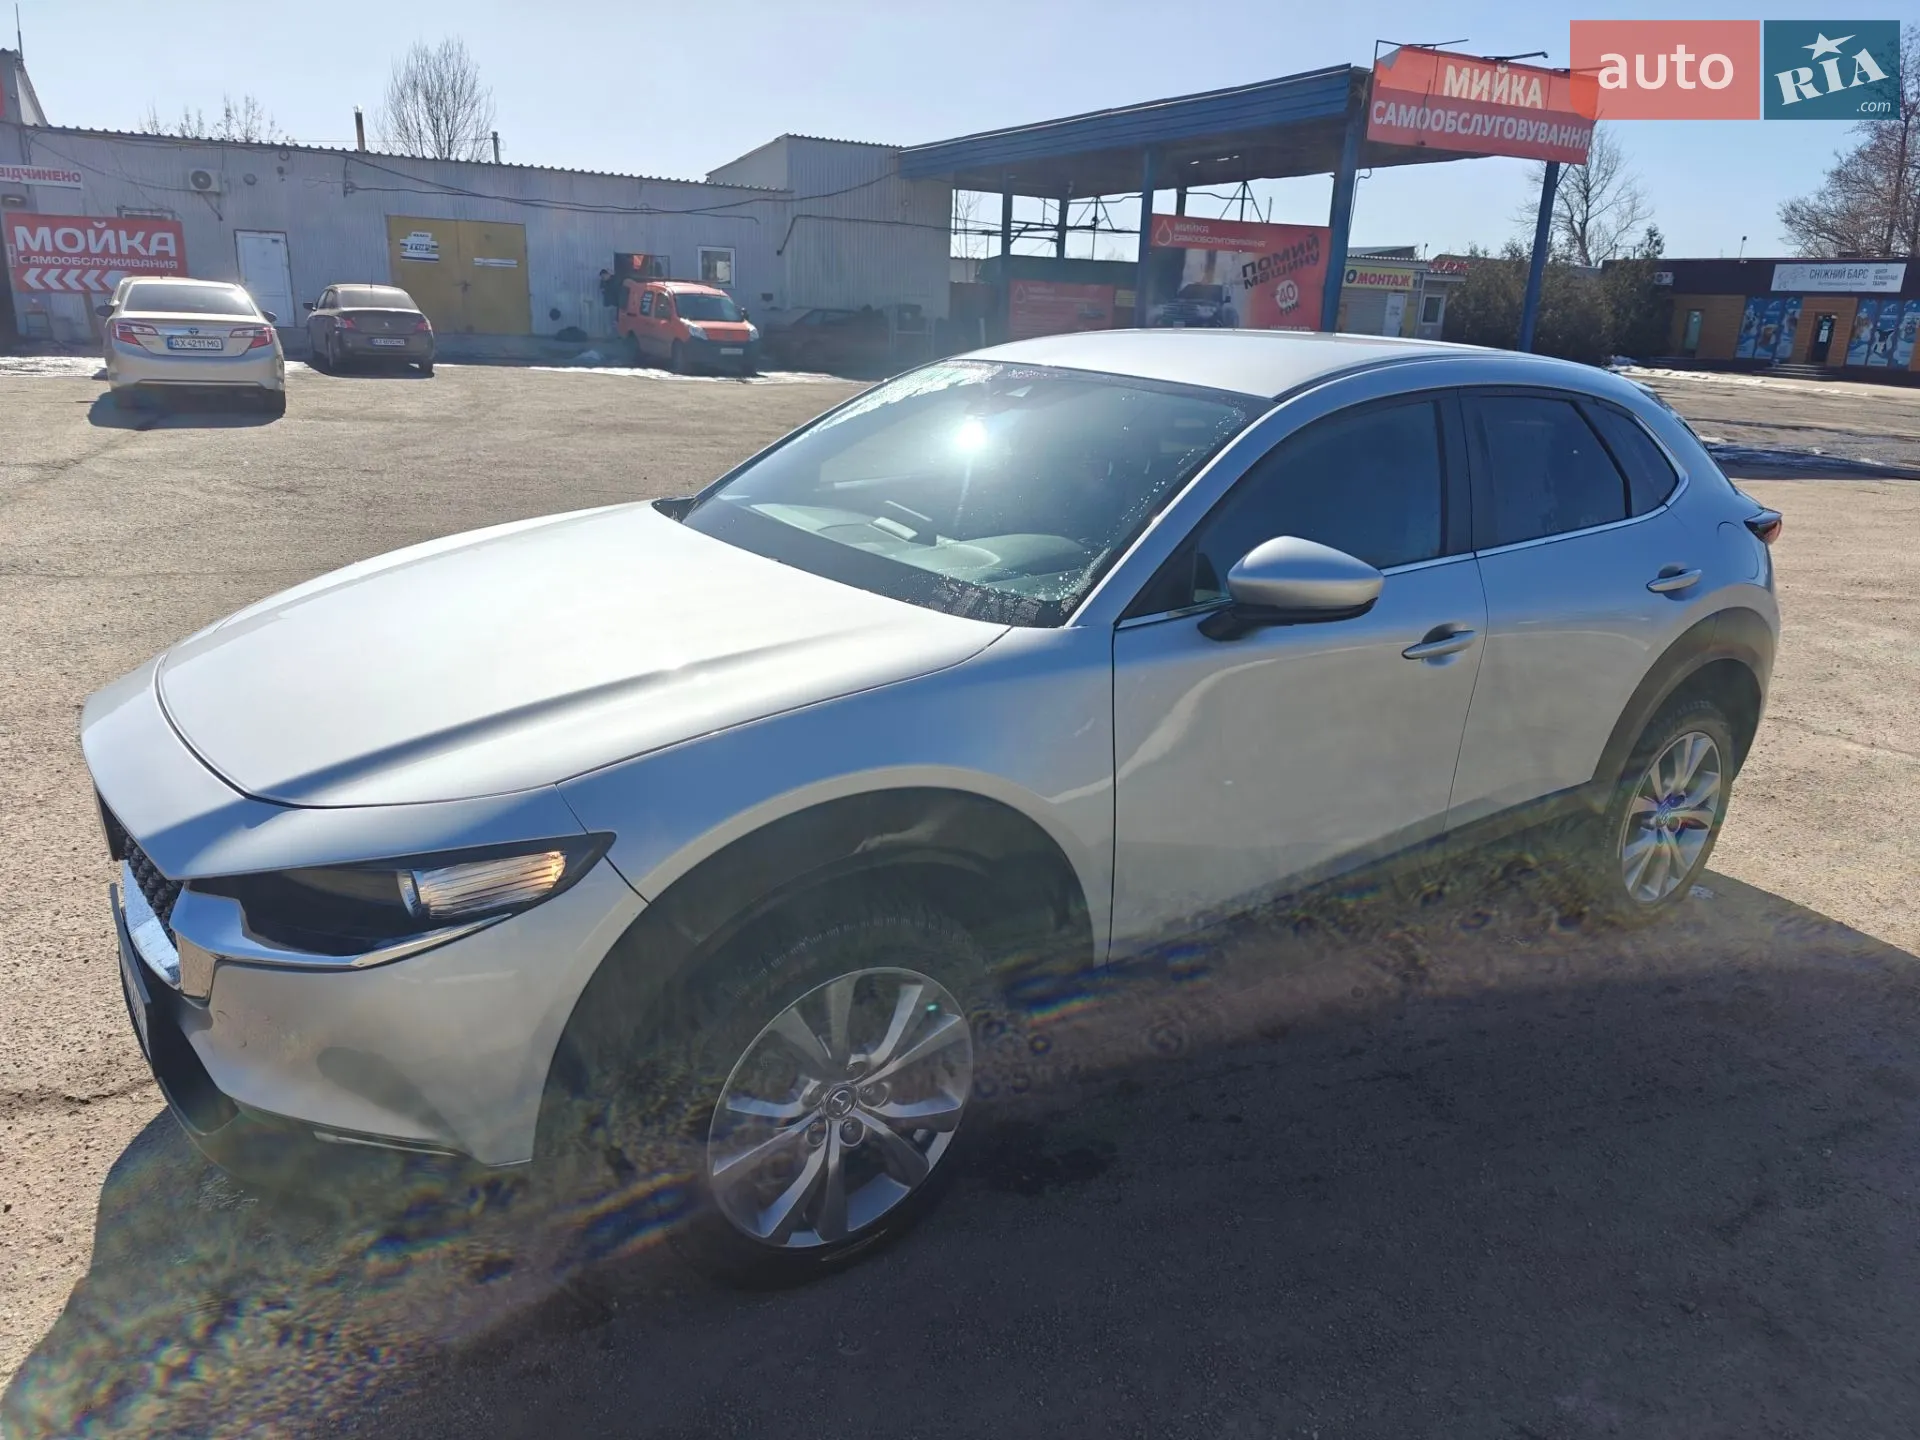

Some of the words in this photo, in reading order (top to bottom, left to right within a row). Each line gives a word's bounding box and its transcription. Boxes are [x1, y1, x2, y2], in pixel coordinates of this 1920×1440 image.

[1442, 63, 1544, 110] МИЙКА
[1371, 101, 1592, 150] САМООБСЛУГОВУВАННЯ
[0, 166, 82, 183] ВІДЧИНЕНО
[14, 221, 177, 257] МОЙКА
[19, 254, 179, 269] САМООБСЛУЖИВАНИЯ
[1241, 231, 1320, 278] ПОМИЙ
[1809, 267, 1847, 280] СНІЖНИЙ
[1847, 268, 1869, 280] БАРС
[1279, 283, 1296, 304] 40
